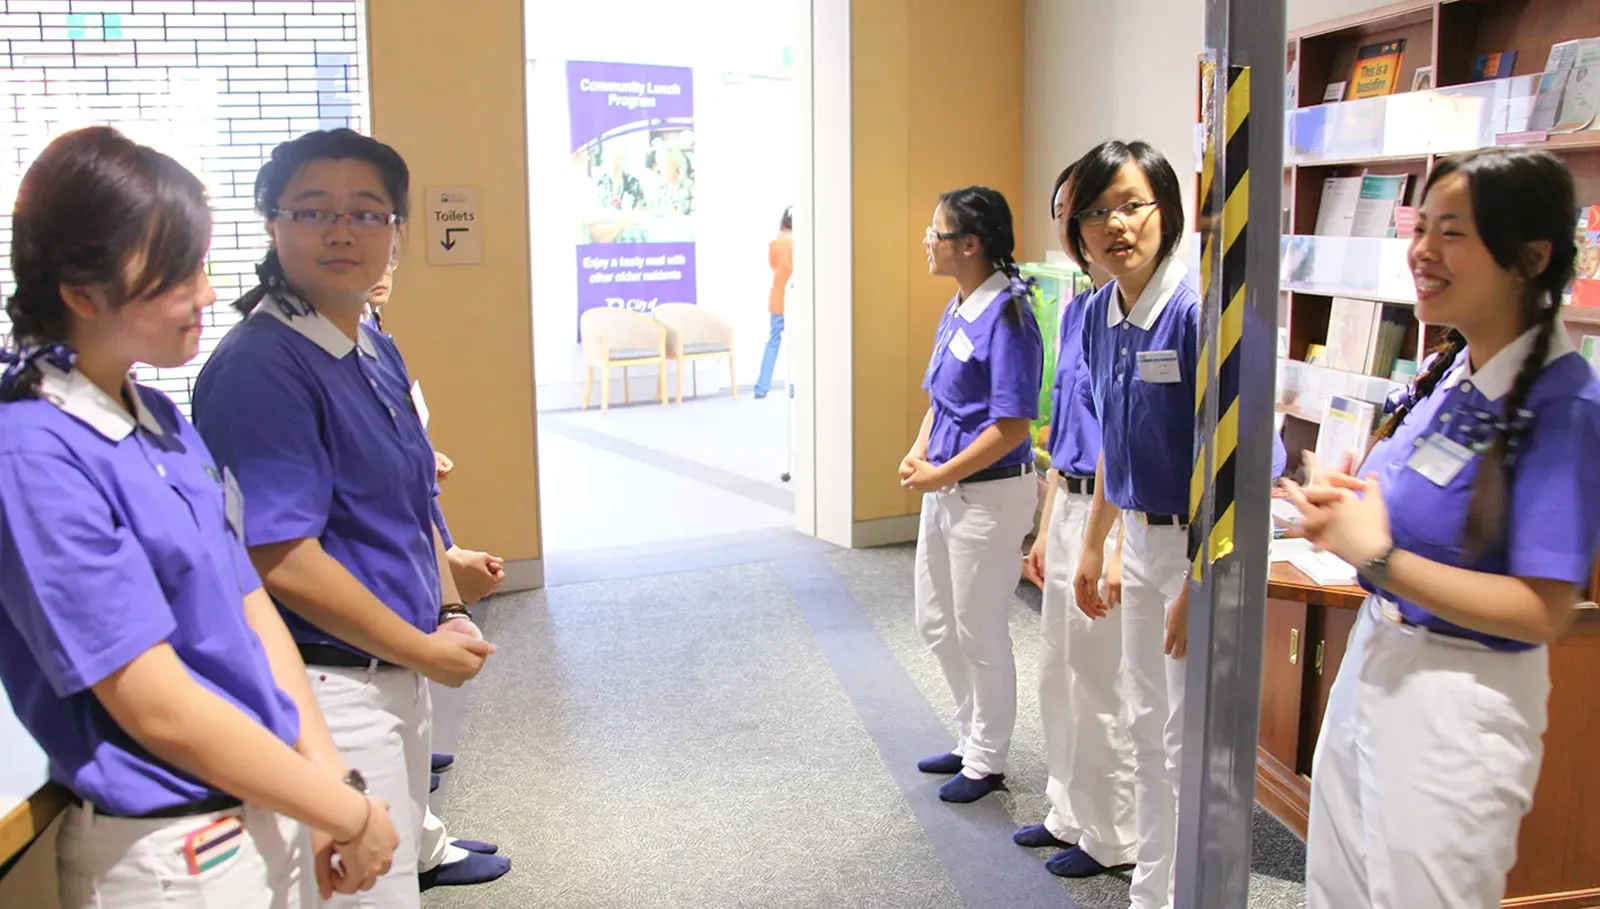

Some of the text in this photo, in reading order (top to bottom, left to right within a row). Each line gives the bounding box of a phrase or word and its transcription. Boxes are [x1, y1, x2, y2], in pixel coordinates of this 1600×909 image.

[1361, 62, 1388, 78] This is a
[580, 78, 680, 96] Community Lunch
[1356, 78, 1386, 93] bushfire
[608, 93, 656, 109] Program
[434, 210, 475, 222] Toilets
[583, 254, 686, 270] Enjoy a tasty meal with
[589, 270, 682, 284] other older residents
[626, 299, 647, 312] City
[647, 297, 658, 310] of
